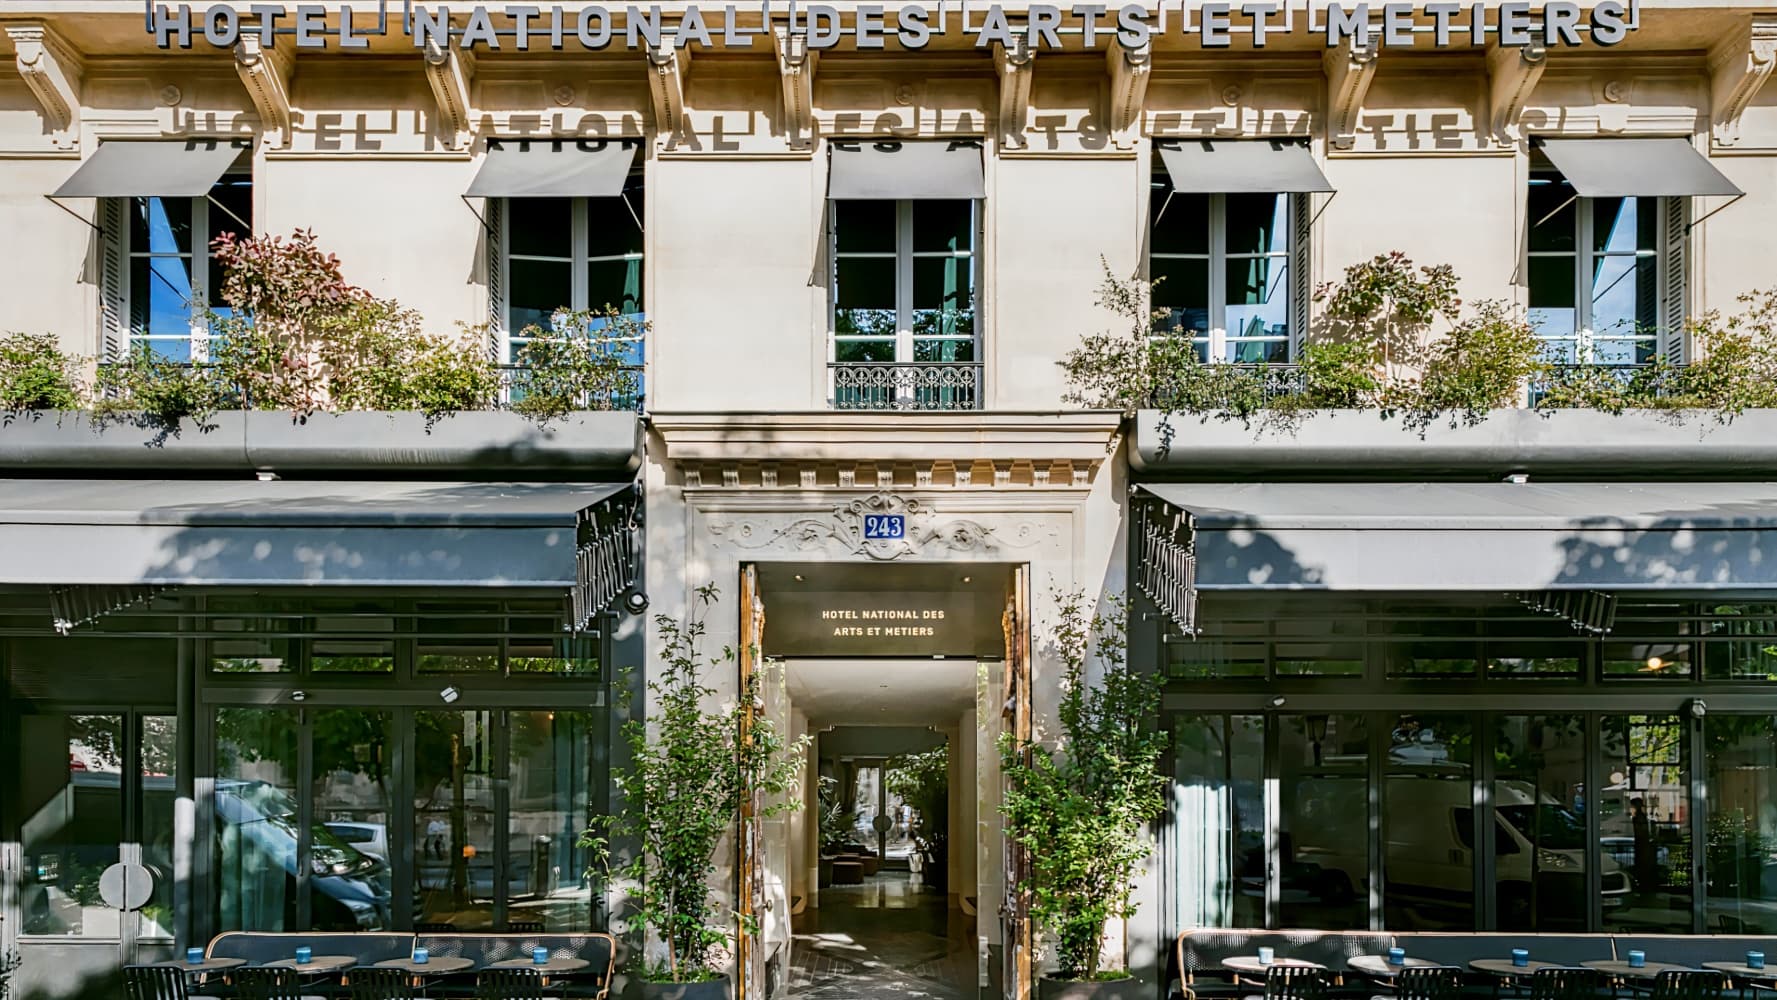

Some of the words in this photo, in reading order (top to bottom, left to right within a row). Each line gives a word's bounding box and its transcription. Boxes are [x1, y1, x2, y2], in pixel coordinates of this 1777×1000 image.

[154, 4, 369, 49] HOTEL
[414, 5, 753, 49] NATIONAL
[807, 4, 930, 49] DES
[975, 4, 1150, 49] ARTS
[1201, 2, 1276, 47] ET
[1326, 1, 1627, 47] METIERS
[867, 517, 902, 536] 243
[822, 610, 858, 620] HOTEL
[862, 610, 919, 620] NATIONAL
[922, 610, 945, 620] DES
[833, 627, 863, 636] ARTS
[867, 627, 881, 636] ET
[885, 627, 934, 636] METIERS
